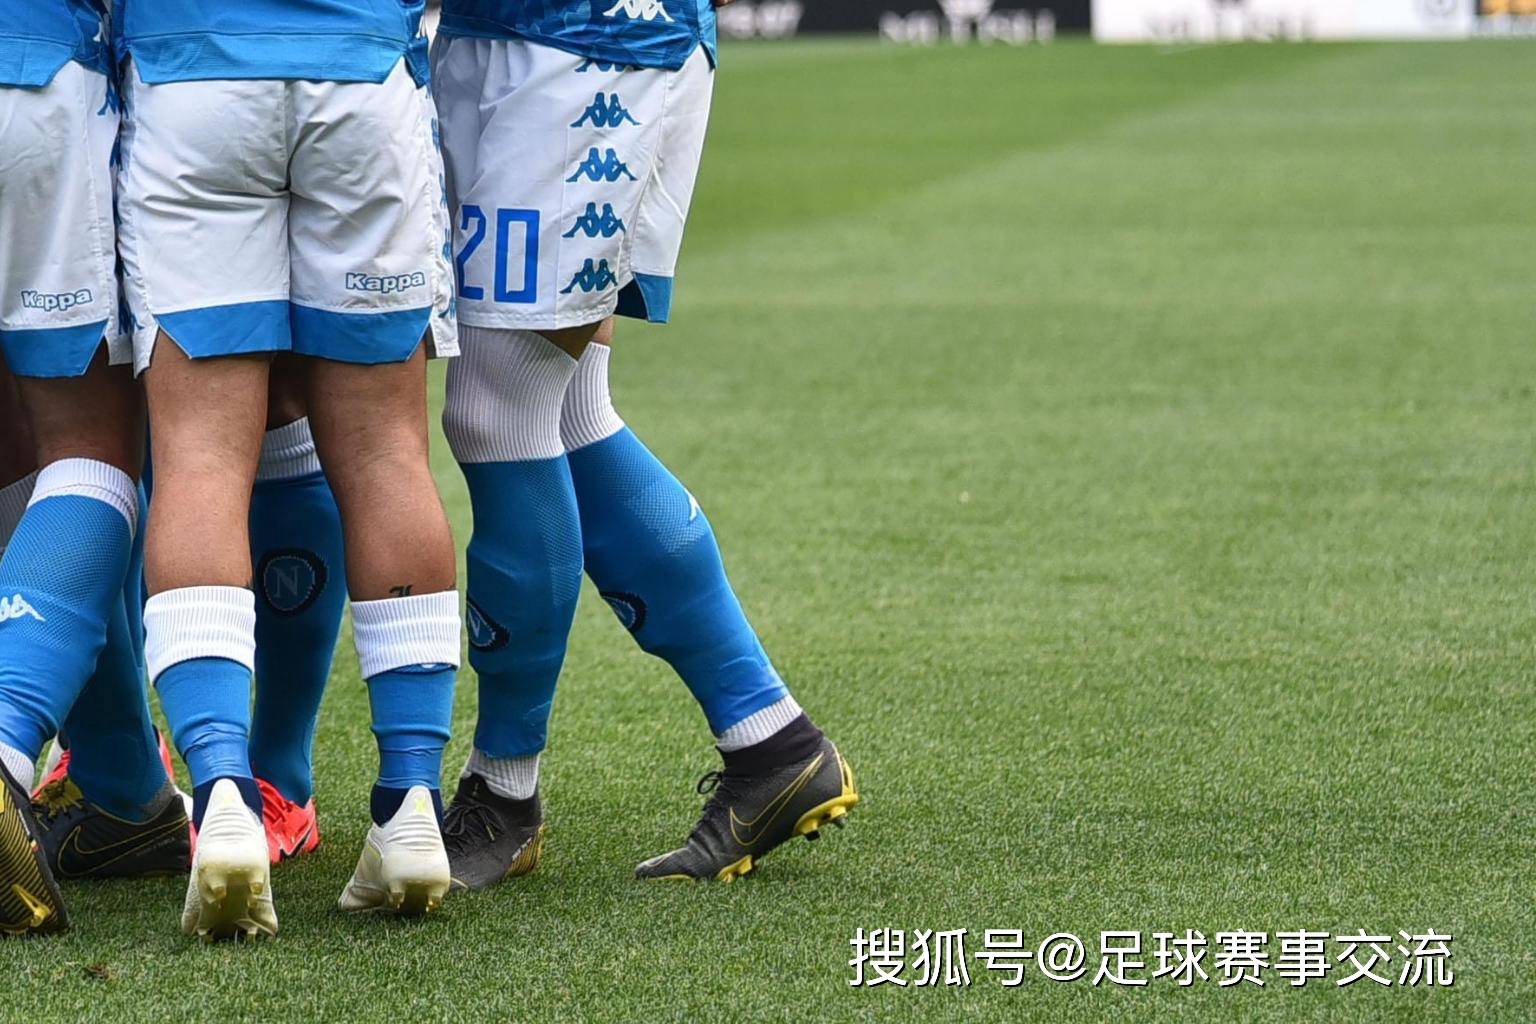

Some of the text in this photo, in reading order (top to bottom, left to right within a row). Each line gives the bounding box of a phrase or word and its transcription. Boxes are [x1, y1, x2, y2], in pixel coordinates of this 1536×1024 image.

[455, 203, 541, 304] 20
[345, 271, 426, 294] Kappa
[20, 288, 93, 312] Kappa
